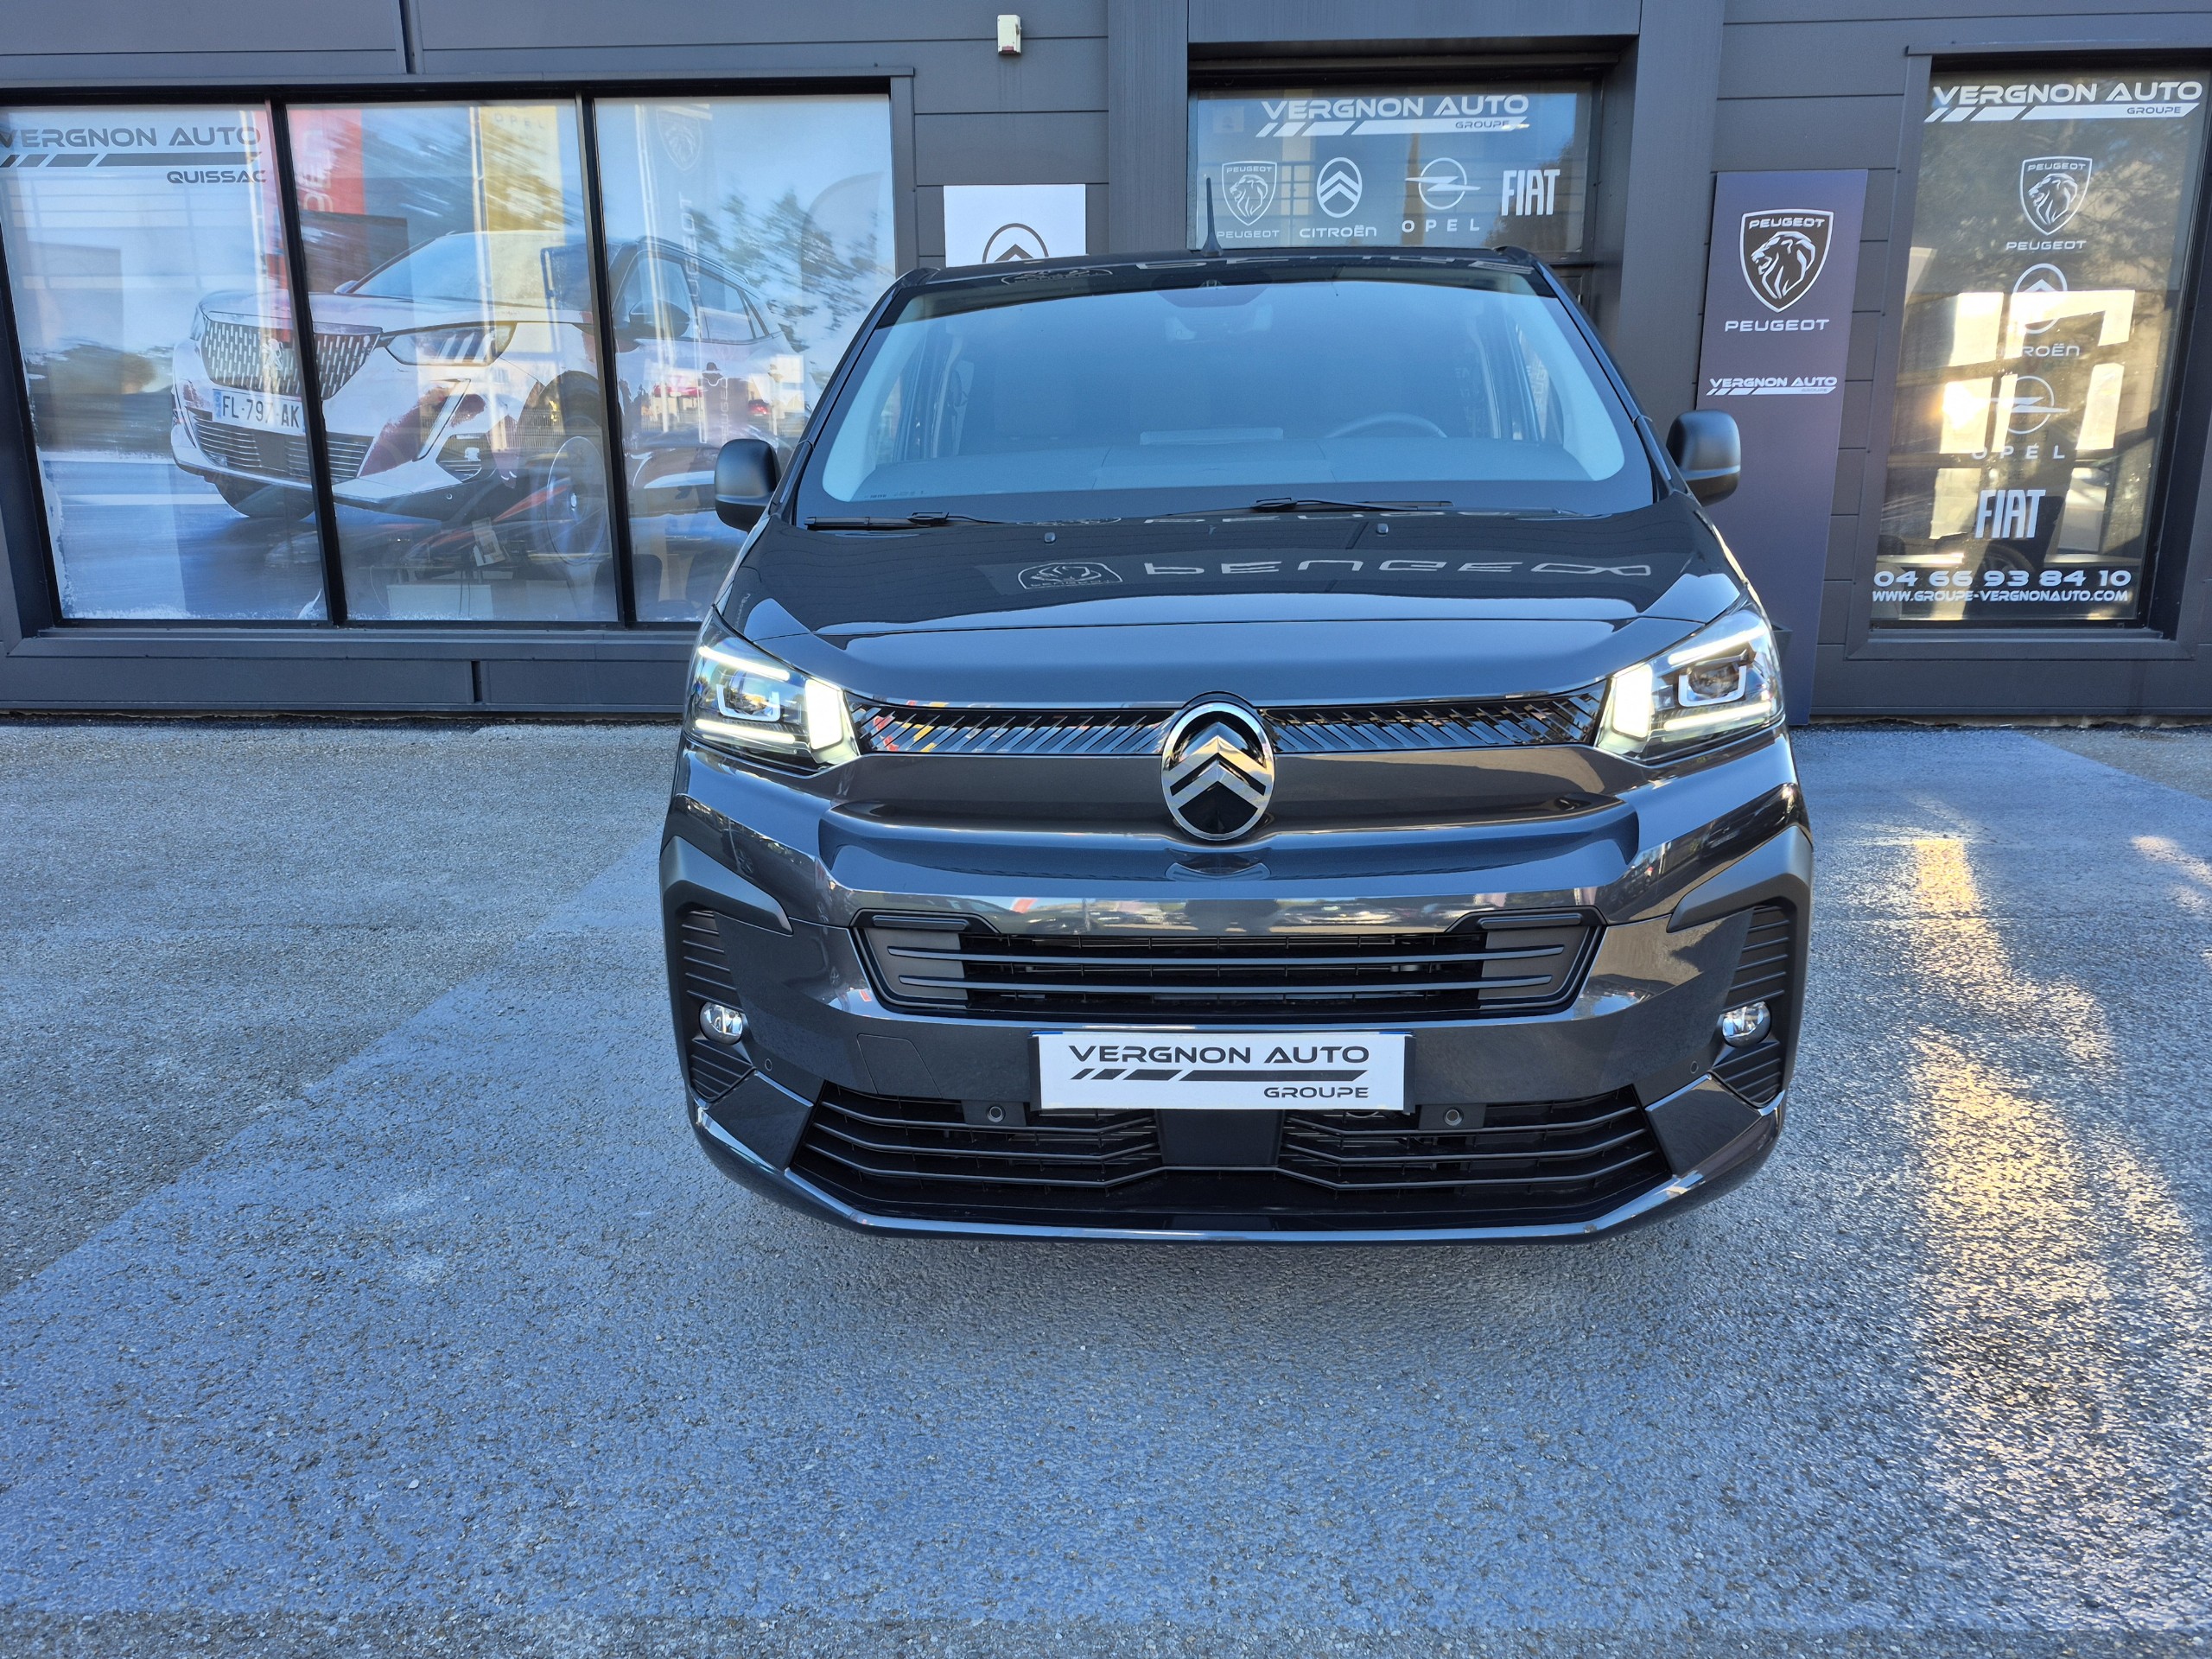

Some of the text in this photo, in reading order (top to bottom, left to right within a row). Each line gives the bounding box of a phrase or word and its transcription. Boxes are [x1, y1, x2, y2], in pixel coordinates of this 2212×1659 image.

[1932, 81, 2202, 105] VERGNON AUTO
[1261, 94, 1529, 119] VERGNON AUTO
[168, 127, 263, 146] AUTO
[2027, 162, 2086, 172] PEUGEOT
[167, 170, 266, 184] QUISSAC
[1501, 169, 1560, 216] FIAT
[1402, 219, 1480, 233] OPEL
[1749, 218, 1825, 230] PEUGEOT
[1217, 230, 1280, 238] PEUGEOT
[2005, 240, 2087, 251] PEUGEOT
[1725, 319, 1830, 332] PEUGEOT
[1709, 377, 1838, 388] VERGNON AUTO
[1974, 489, 2046, 538] FIAT
[1873, 570, 2132, 587] 04 66 93 84 10
[1872, 591, 2128, 602] WWW.GROUPE-VERGNONAUTO.COM
[1068, 1046, 1370, 1064] VERGNON AUTO
[1264, 1087, 1370, 1098] GROUPE
